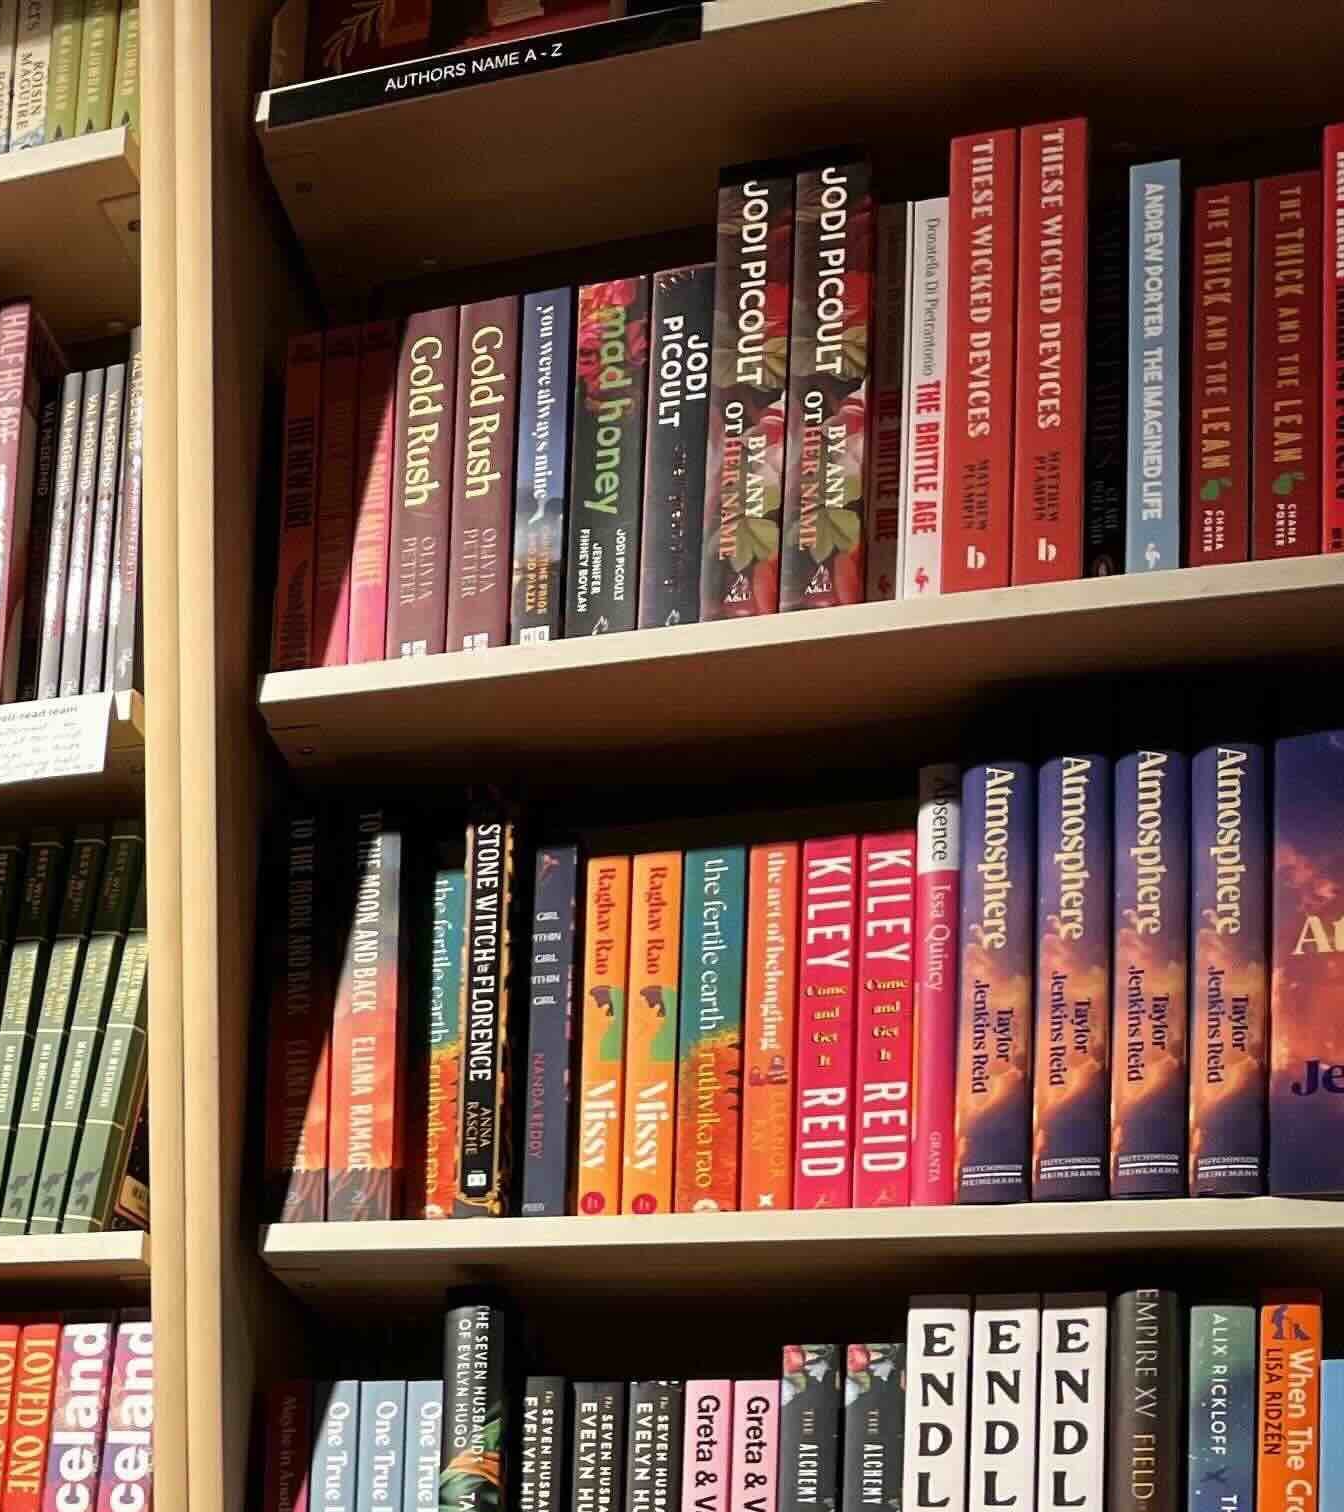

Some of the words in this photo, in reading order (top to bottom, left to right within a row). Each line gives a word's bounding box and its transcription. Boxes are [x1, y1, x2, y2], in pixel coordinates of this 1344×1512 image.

[385, 61, 466, 91] AUTHORS
[472, 52, 519, 73] NAME
[551, 44, 563, 57] Z
[969, 138, 994, 218] THESE
[967, 227, 993, 324] WICKED
[596, 306, 633, 391] mad
[966, 334, 991, 438] DEVICES
[584, 399, 632, 515] honey
[981, 767, 1016, 950] Atmosphere
[1287, 1348, 1314, 1419] When
[697, 1395, 719, 1462] Greta
[1285, 1428, 1312, 1470] The
[695, 1472, 718, 1488] &
